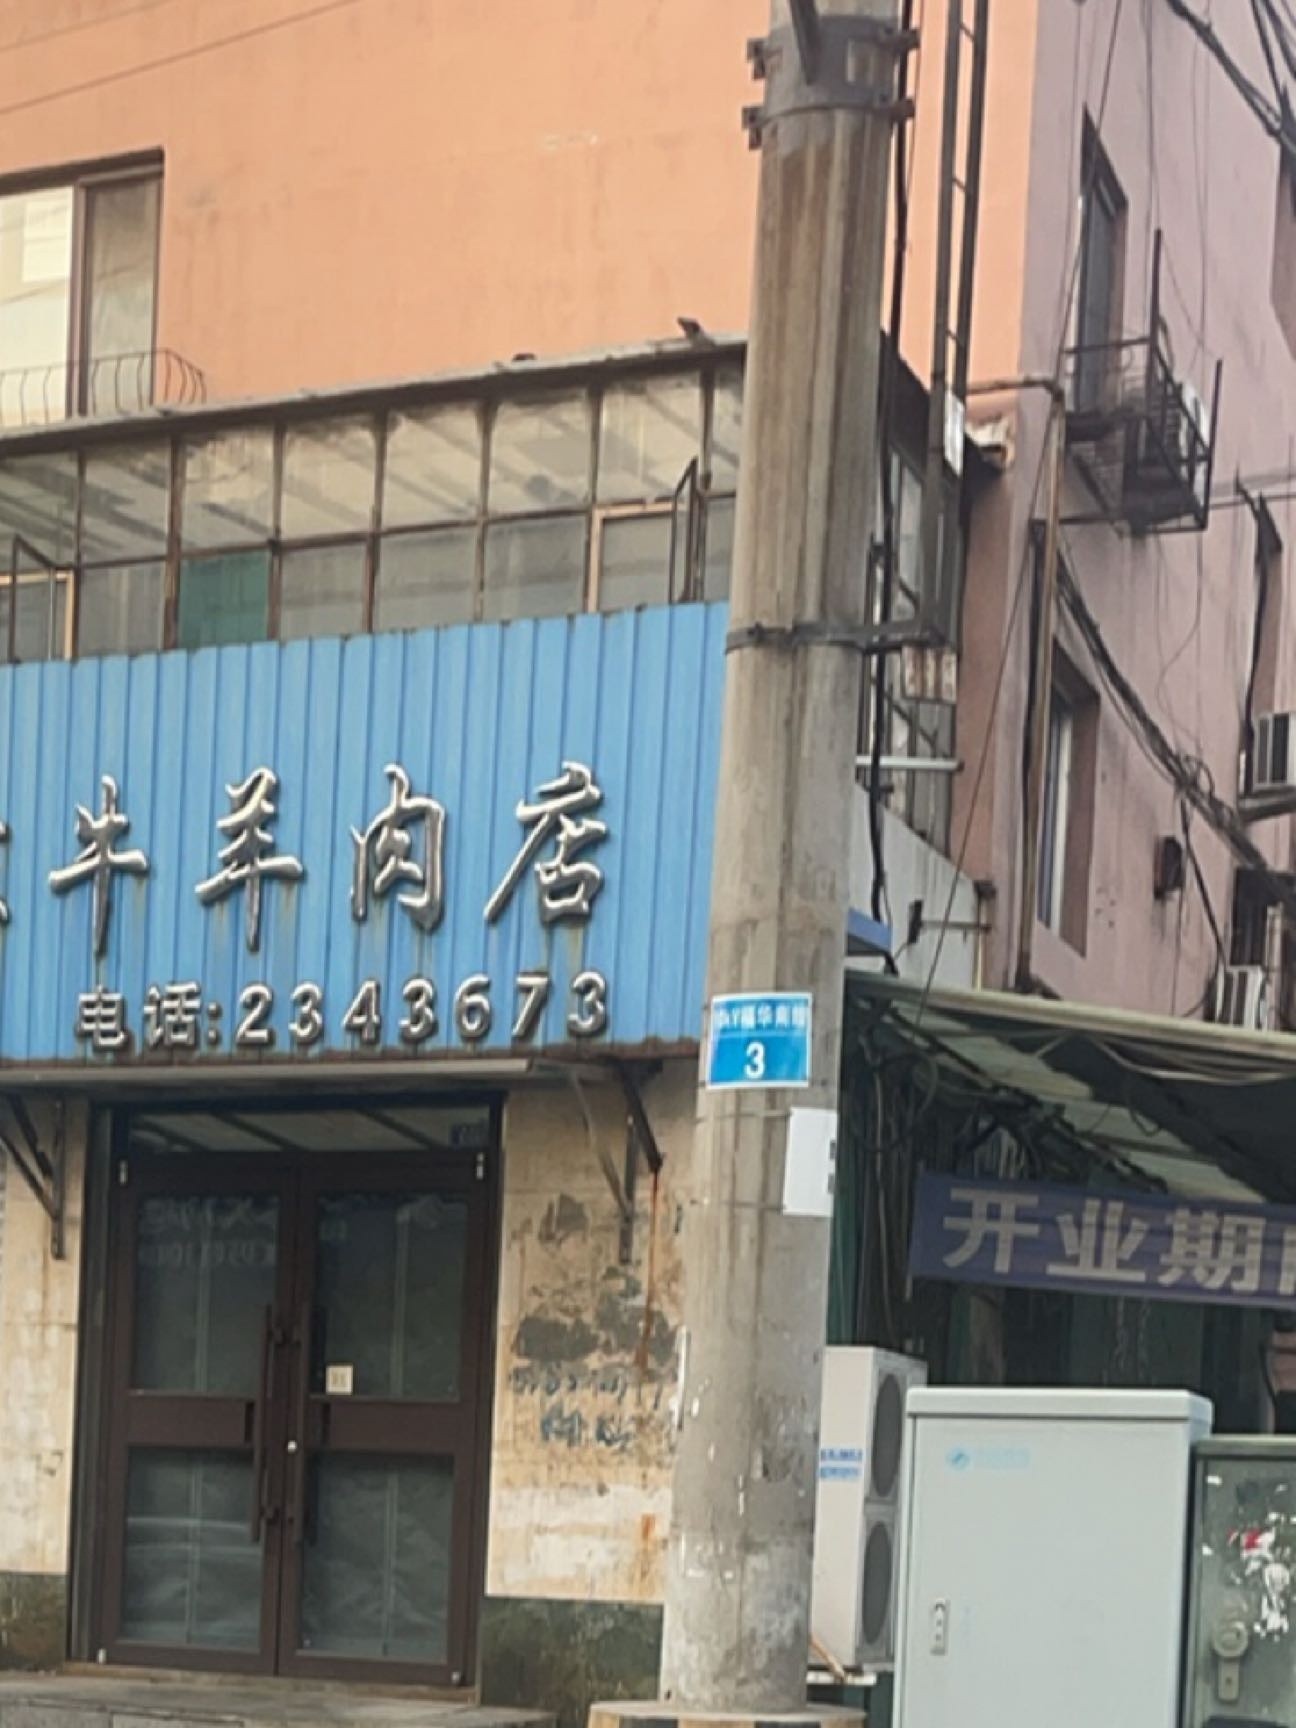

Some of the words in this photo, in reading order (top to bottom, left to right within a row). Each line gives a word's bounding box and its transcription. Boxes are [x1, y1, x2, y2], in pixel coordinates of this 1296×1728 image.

[745, 1041, 766, 1079] 3
[942, 1187, 1296, 1295] 开业期
